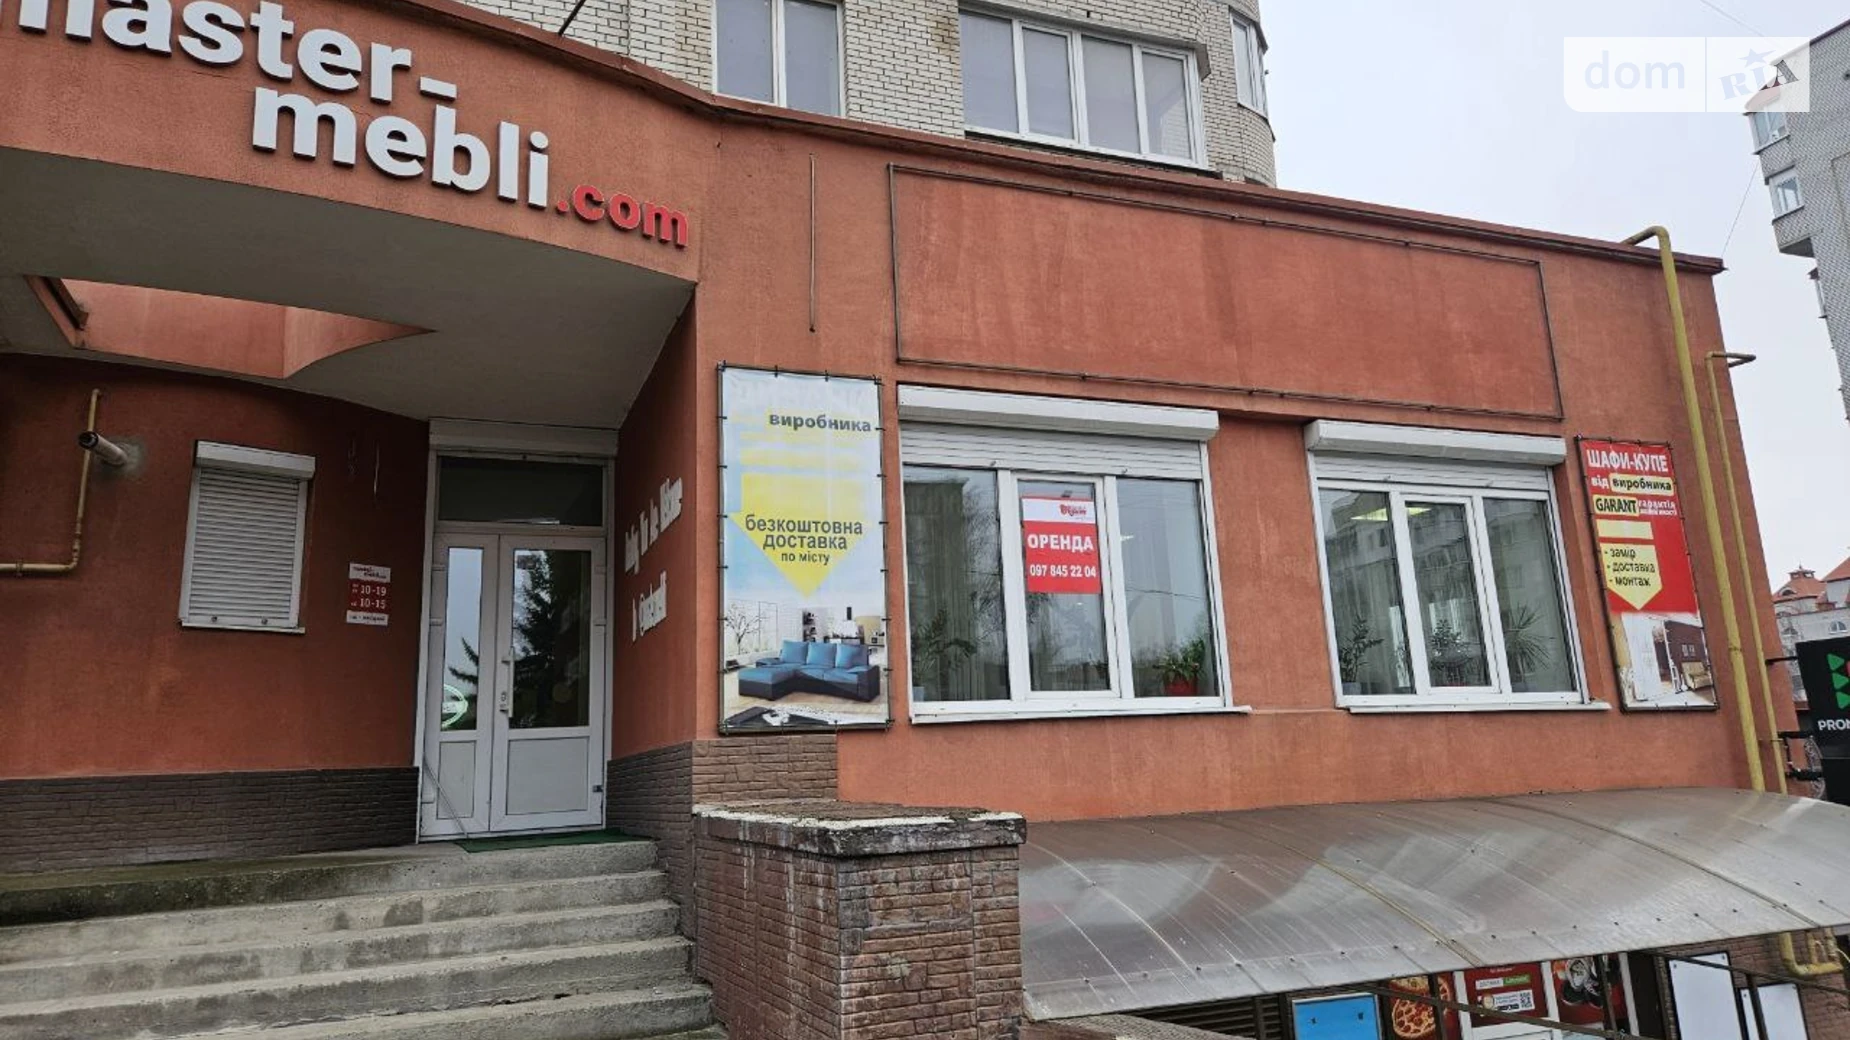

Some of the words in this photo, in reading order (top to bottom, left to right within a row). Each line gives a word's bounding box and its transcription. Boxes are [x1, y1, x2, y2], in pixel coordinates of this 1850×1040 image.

[769, 413, 872, 432] виробника
[1586, 449, 1669, 473] ШАФИ-КУПЕ
[1590, 475, 1610, 489] від
[1612, 478, 1672, 491] виробника
[1595, 498, 1637, 513] GARANT
[745, 514, 863, 535] безкоштовна
[762, 533, 848, 551] доставка
[1027, 533, 1094, 553] ОРЕНДА
[781, 552, 796, 563] по
[799, 550, 830, 566] місту
[1029, 564, 1047, 578] 097
[1050, 564, 1068, 578] 845
[1070, 565, 1083, 579] 22
[1085, 566, 1097, 579] 04
[1612, 562, 1656, 573] доставка
[360, 585, 387, 597] 10-19
